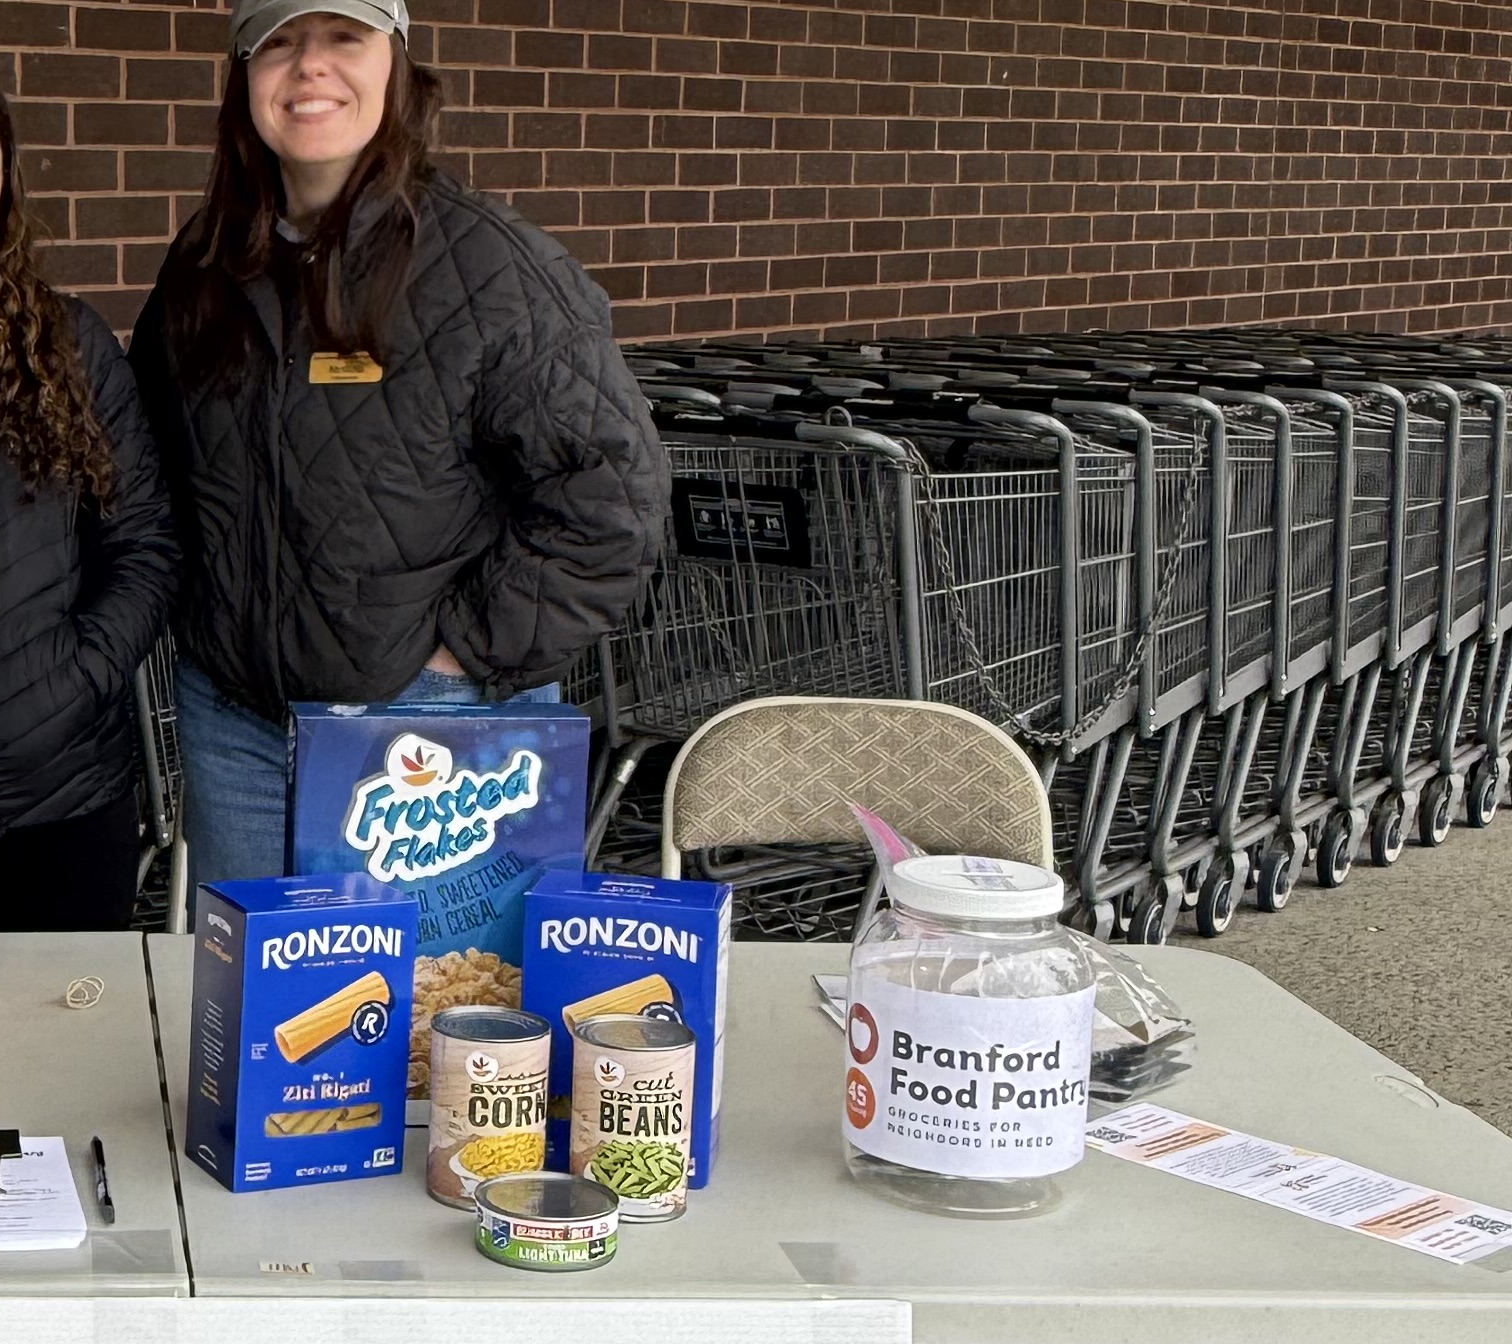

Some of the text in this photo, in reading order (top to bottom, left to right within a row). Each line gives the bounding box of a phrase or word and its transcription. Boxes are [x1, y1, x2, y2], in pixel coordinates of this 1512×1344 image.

[356, 754, 532, 841] Frosted
[381, 817, 489, 873] Flakes
[436, 850, 524, 908] SWEETENED
[445, 896, 503, 936] CEREAL
[261, 924, 403, 970] RONZONI
[541, 917, 698, 964] RONZONI
[892, 1030, 1061, 1073] Branford
[468, 1089, 546, 1129] CORN
[848, 1080, 867, 1107] 45
[890, 1066, 1086, 1111] Food Pantry
[599, 1103, 683, 1137] BEANS
